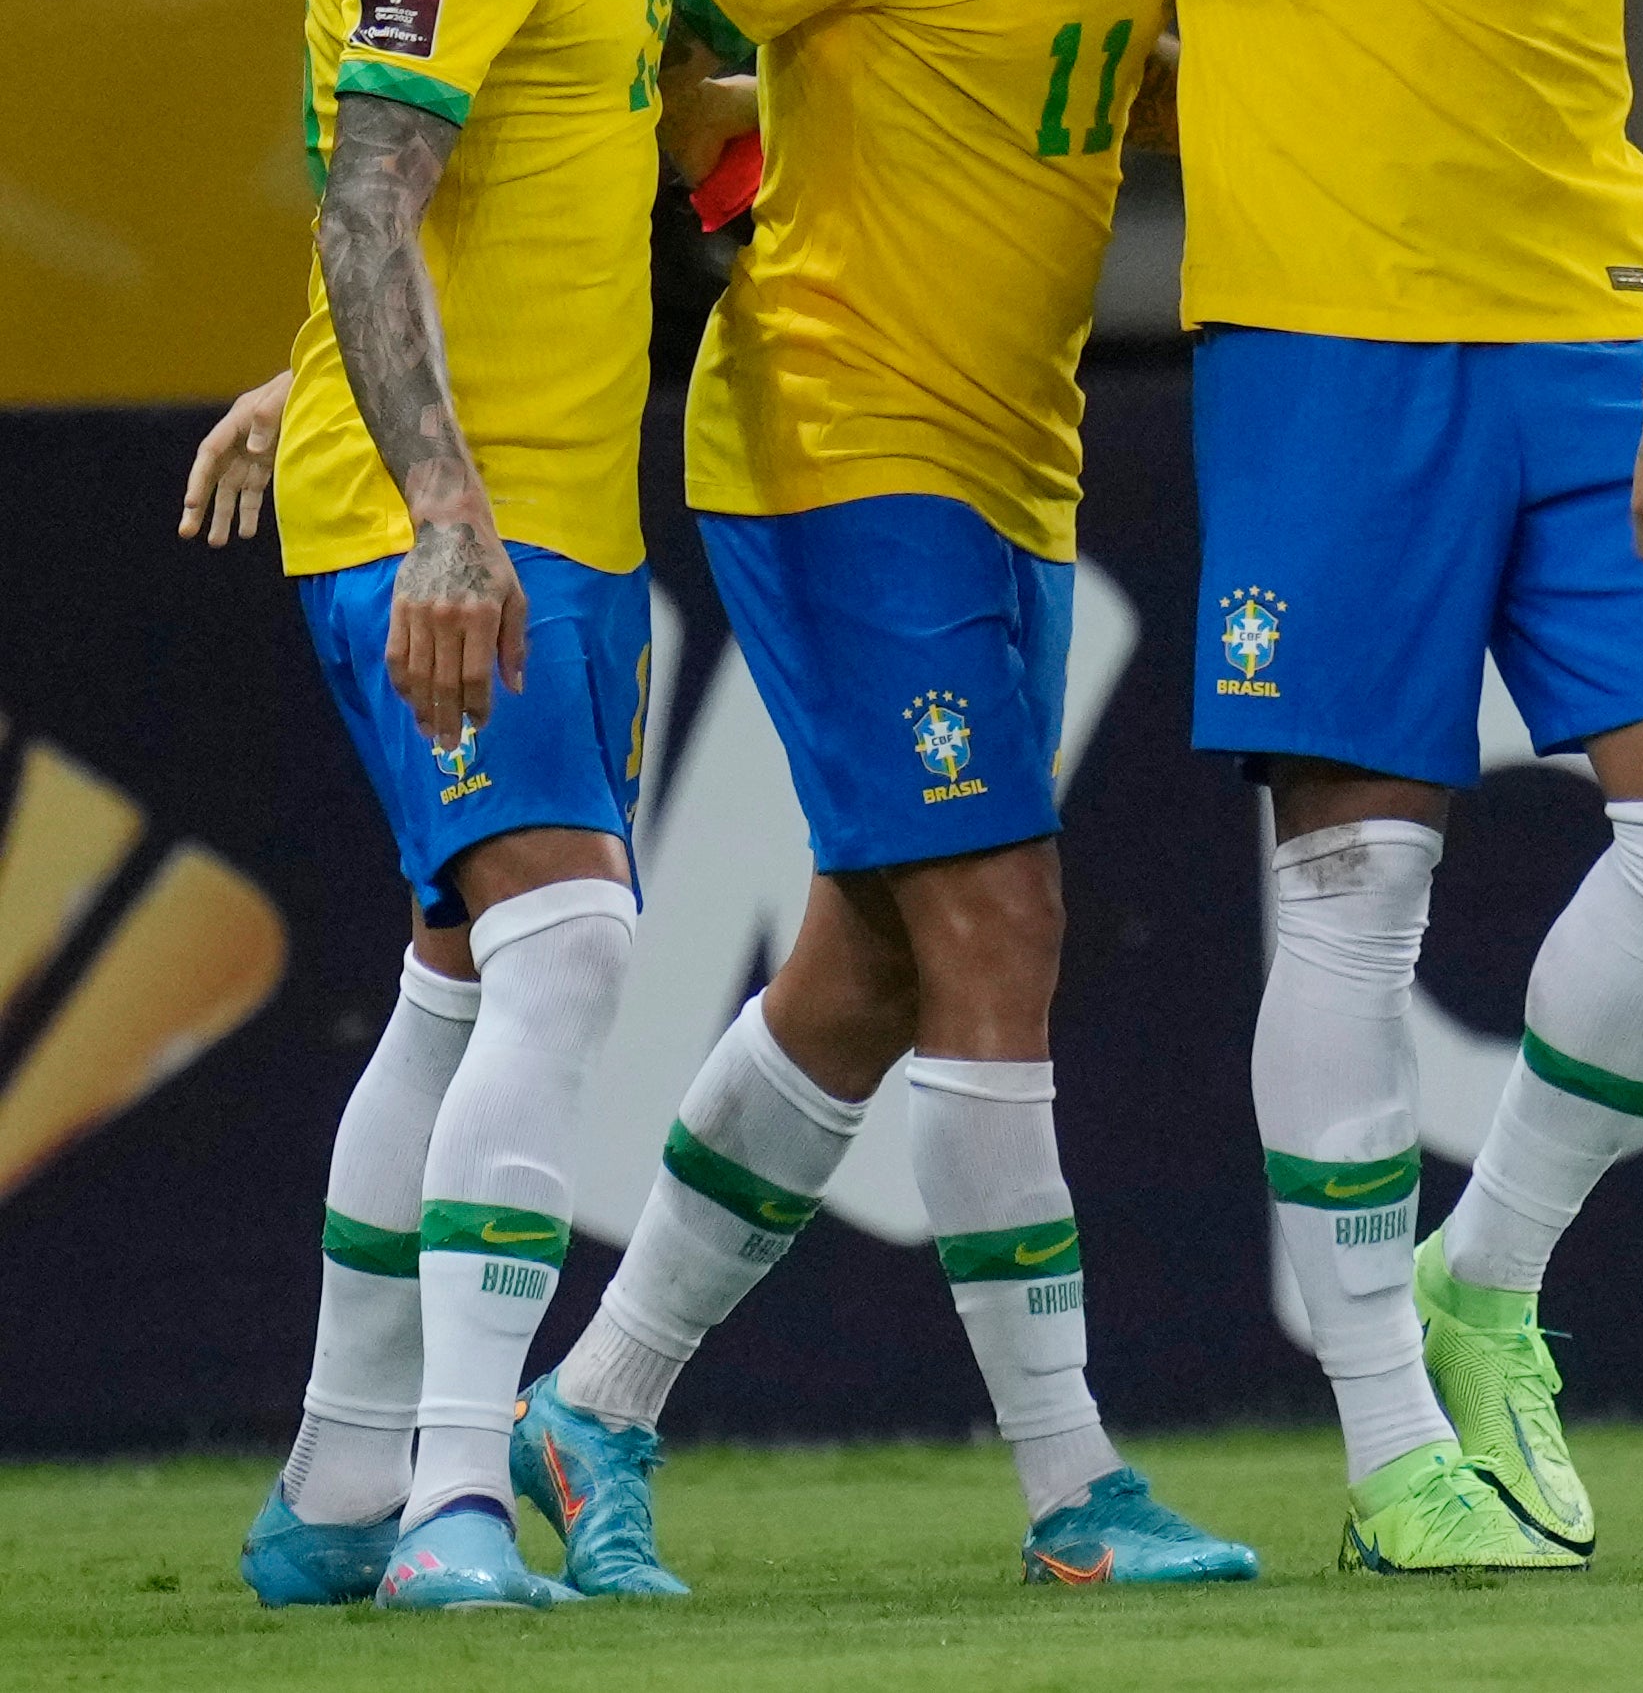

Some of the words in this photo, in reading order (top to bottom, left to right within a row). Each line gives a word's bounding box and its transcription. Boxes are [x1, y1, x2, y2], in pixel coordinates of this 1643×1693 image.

[1037, 19, 1134, 156] 11
[1239, 632, 1262, 642] CBF
[1216, 679, 1281, 698] BRASIL
[931, 734, 953, 747] CBF
[440, 772, 493, 805] BRASIL
[922, 778, 989, 804] BRASIL
